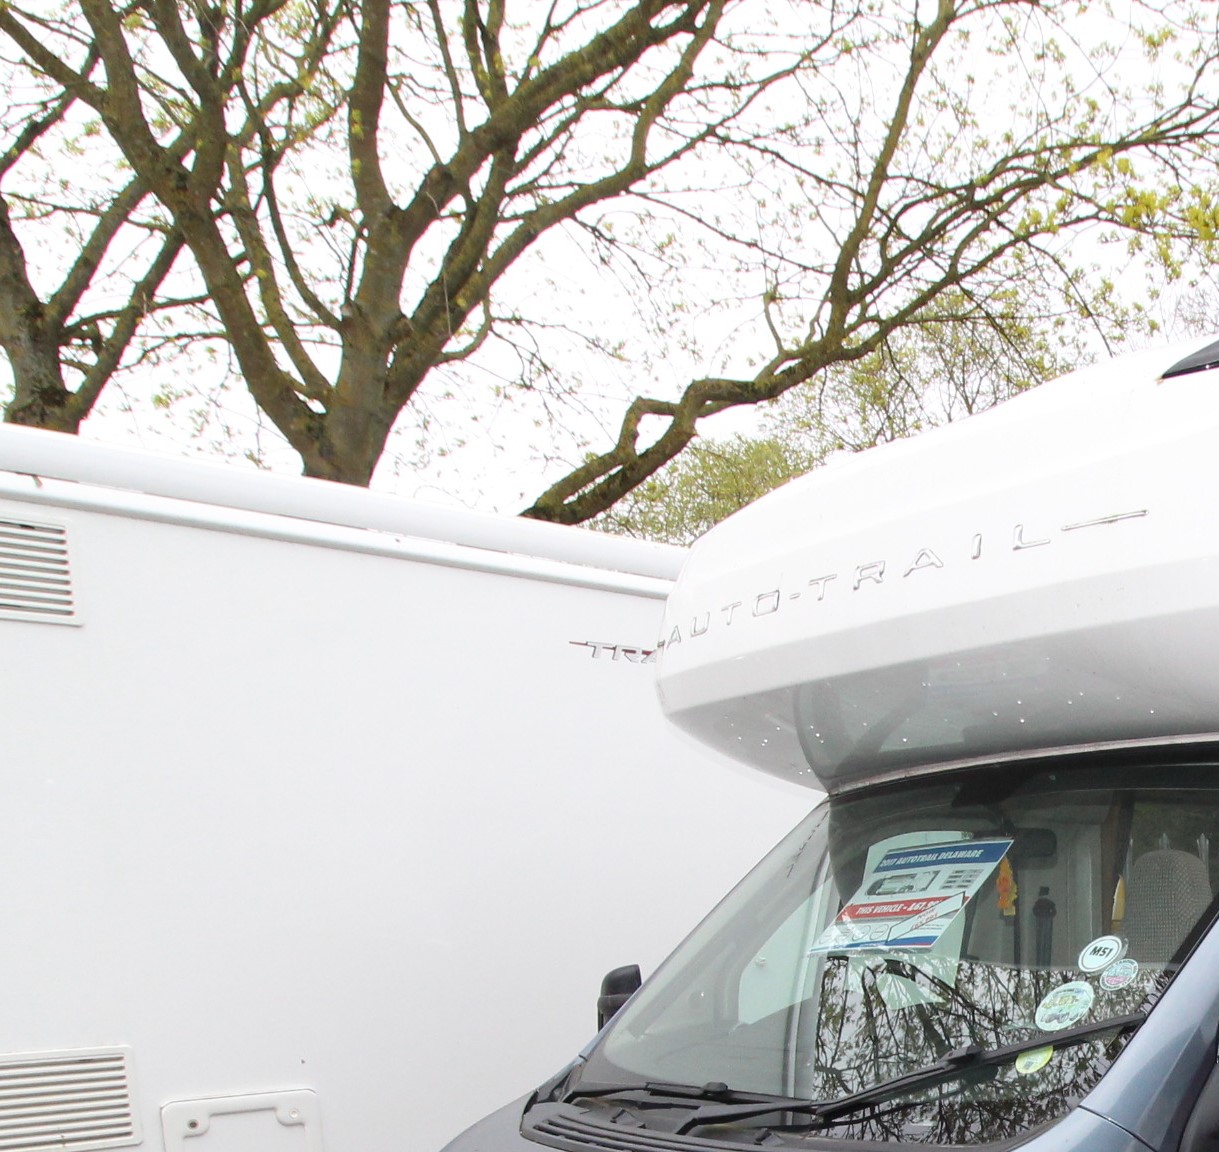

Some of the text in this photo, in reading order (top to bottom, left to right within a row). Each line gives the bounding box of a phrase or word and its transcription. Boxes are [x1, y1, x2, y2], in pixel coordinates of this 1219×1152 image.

[666, 523, 1051, 649] AUTO-TRAIL
[896, 853, 939, 865] AUTOTRAIL
[938, 849, 984, 860] DELAWARE
[856, 905, 873, 915] THIS
[873, 903, 904, 914] VEHICLE
